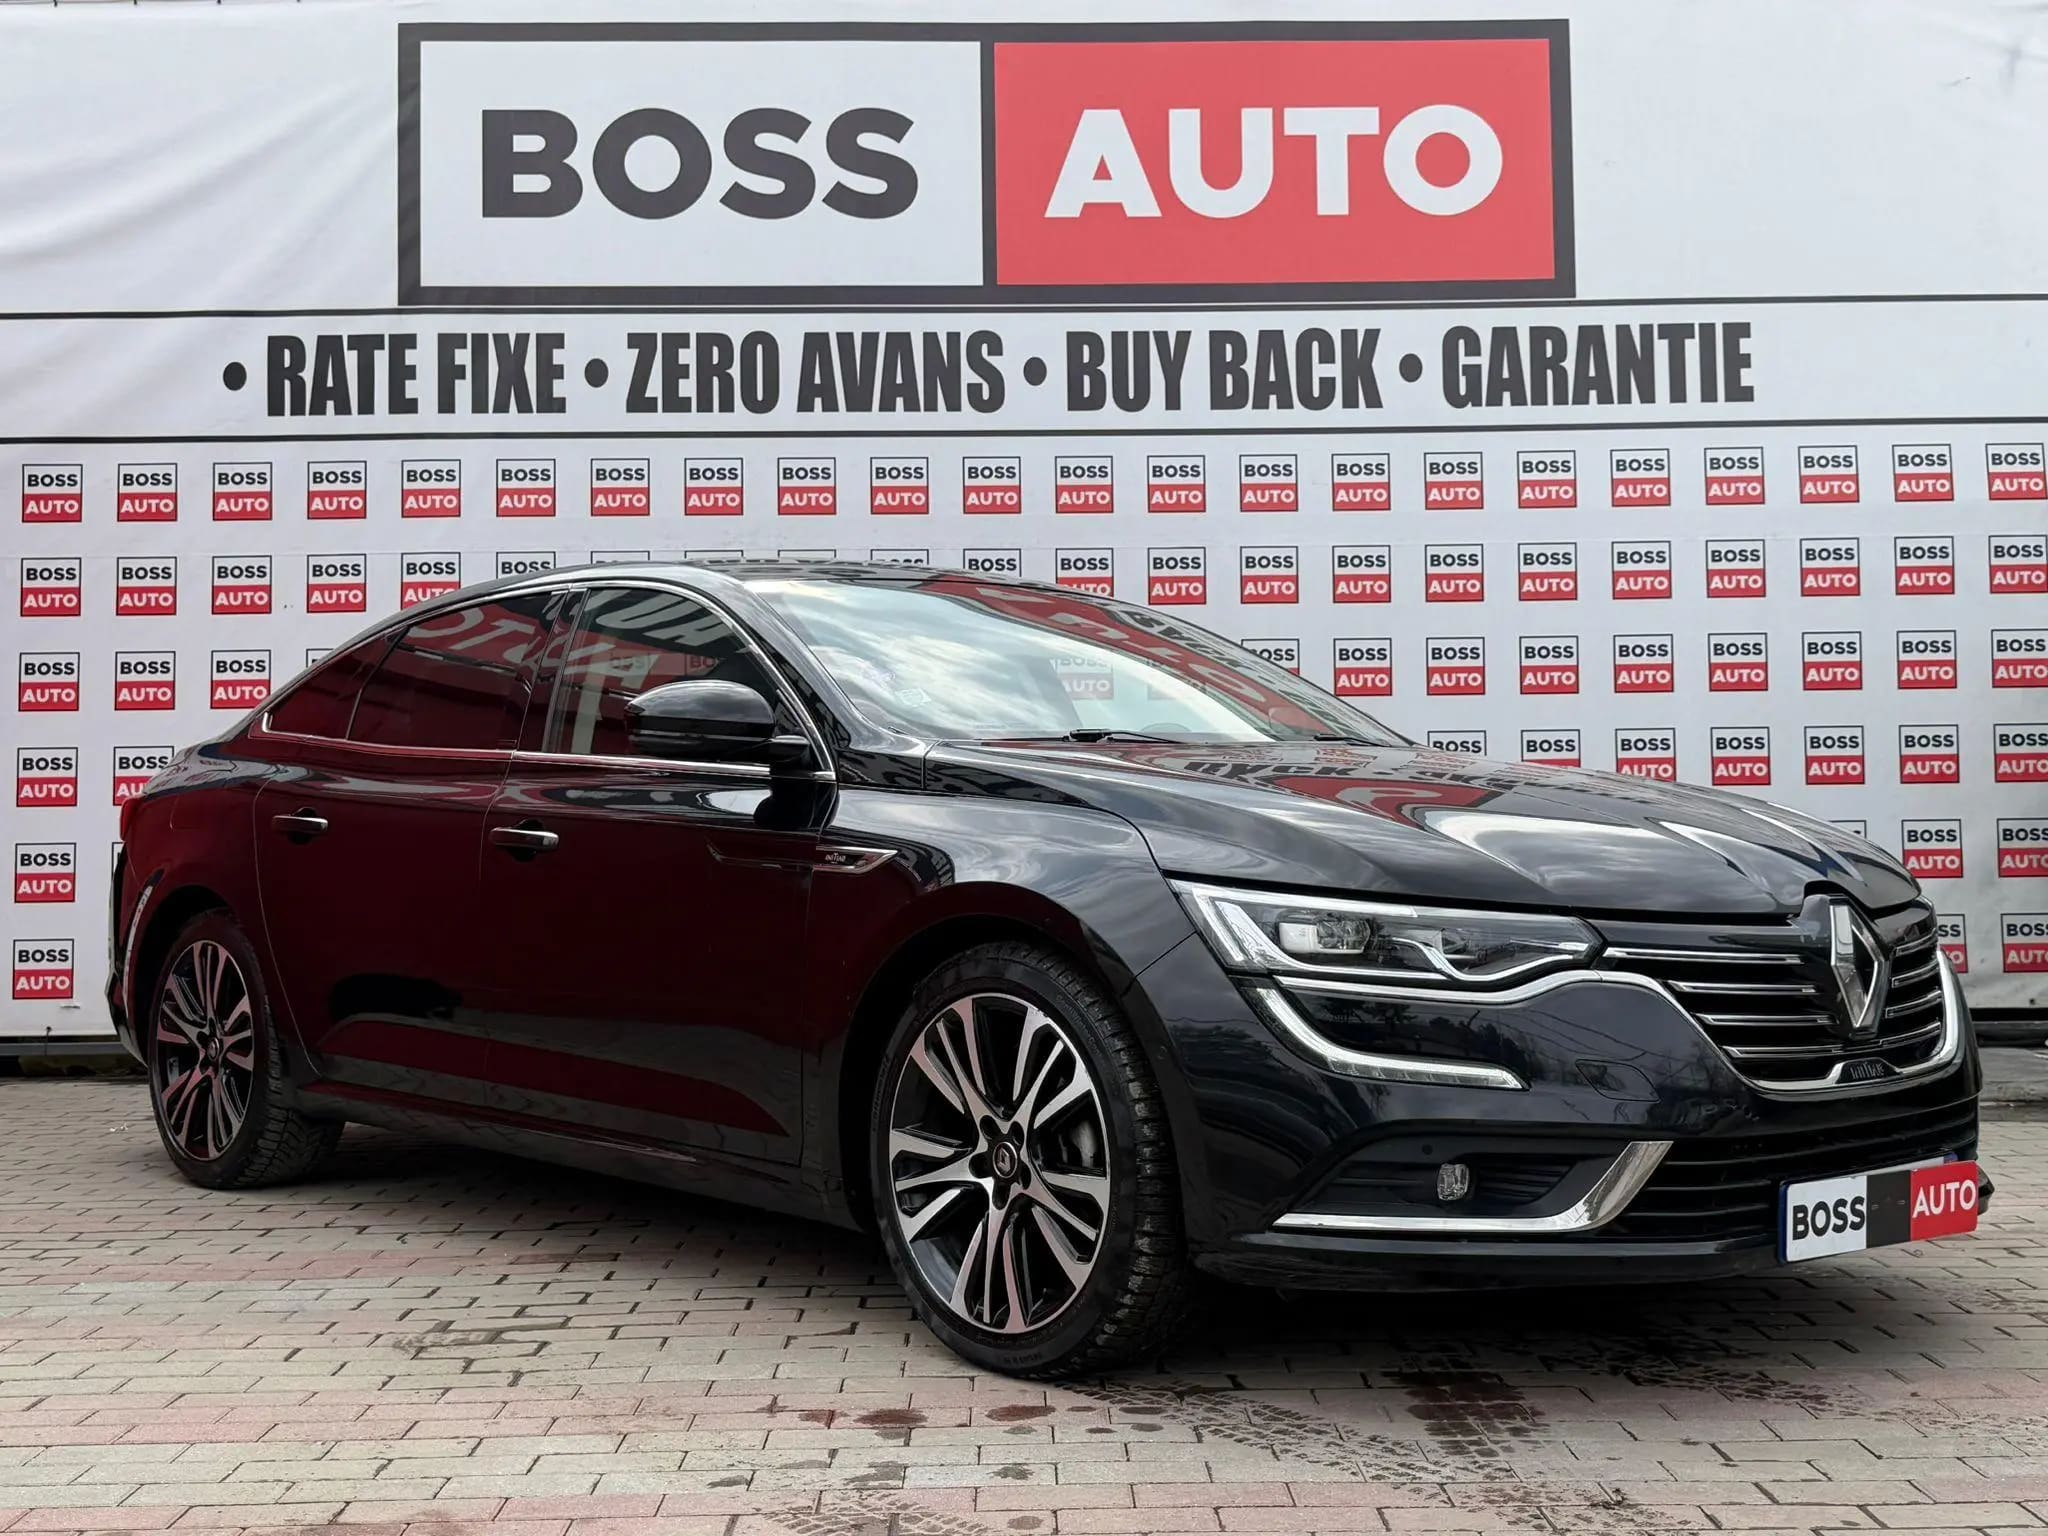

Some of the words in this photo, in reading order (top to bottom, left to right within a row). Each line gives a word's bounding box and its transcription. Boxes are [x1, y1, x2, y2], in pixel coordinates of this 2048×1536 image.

[481, 107, 918, 220] BOSS
[1044, 103, 1504, 219] AUTO
[267, 332, 419, 417] RATE
[437, 331, 567, 414] FIXE
[625, 330, 780, 415] ZERO
[796, 330, 1006, 414] AVANS
[1066, 330, 1192, 412] BUY
[1208, 327, 1384, 411] BACK
[1442, 322, 1755, 409] GARANTIE
[1522, 459, 1572, 474] BOSS
[1617, 458, 1666, 472] BOSS
[1710, 456, 1760, 471] BOSS
[1804, 454, 1854, 469] BOSS
[1898, 453, 1948, 467] BOSS
[1992, 452, 2041, 466] BOSS
[406, 468, 457, 483] BOSS
[501, 468, 552, 482] BOSS
[595, 467, 646, 482] BOSS
[689, 467, 739, 481] BOSS
[782, 466, 832, 481] BOSS
[875, 466, 924, 480] BOSS
[967, 465, 1017, 480] BOSS
[1060, 465, 1109, 479] BOSS
[1152, 464, 1201, 478] BOSS
[1244, 463, 1293, 478] BOSS
[1337, 462, 1386, 477] BOSS
[1429, 461, 1479, 476] BOSS
[27, 473, 78, 488] BOSS
[122, 472, 173, 487] BOSS
[217, 471, 268, 486] BOSS
[312, 470, 363, 485] BOSS
[1991, 477, 2044, 492] AUTO
[1521, 485, 1574, 500] AUTO
[1616, 483, 1668, 498] AUTO
[1709, 481, 1762, 497] AUTO
[1803, 480, 1857, 496] AUTO
[1897, 478, 1951, 494] AUTO
[405, 494, 458, 509] AUTO
[499, 494, 553, 508] AUTO
[594, 493, 647, 508] AUTO
[688, 493, 741, 507] AUTO
[781, 492, 833, 507] AUTO
[873, 492, 926, 506] AUTO
[966, 491, 1018, 506] AUTO
[1059, 490, 1111, 505] AUTO
[1150, 490, 1203, 505] AUTO
[1243, 489, 1296, 504] AUTO
[1336, 488, 1388, 503] AUTO
[1428, 486, 1481, 502] AUTO
[25, 500, 79, 514] AUTO
[120, 498, 175, 513] AUTO
[216, 497, 269, 512] AUTO
[310, 496, 364, 511] AUTO
[1523, 551, 1573, 566] BOSS
[1617, 550, 1667, 565] BOSS
[1711, 548, 1761, 563] BOSS
[1805, 547, 1855, 562] BOSS
[1899, 545, 1950, 560] BOSS
[1993, 544, 2044, 559] BOSS
[967, 558, 1017, 572] BOSS
[1061, 557, 1109, 571] BOSS
[1152, 556, 1202, 570] BOSS
[1245, 555, 1294, 569] BOSS
[1337, 554, 1387, 568] BOSS
[1430, 553, 1479, 567] BOSS
[26, 567, 77, 581] BOSS
[121, 566, 173, 580] BOSS
[217, 565, 267, 579] BOSS
[312, 563, 362, 578] BOSS
[406, 561, 457, 576] BOSS
[1616, 576, 1669, 591] AUTO
[1710, 574, 1763, 590] AUTO
[1804, 573, 1857, 588] AUTO
[1898, 572, 1952, 587] AUTO
[1992, 570, 2046, 585] AUTO
[1151, 582, 1204, 597] AUTO
[1244, 581, 1296, 596] AUTO
[1336, 580, 1388, 595] AUTO
[1429, 579, 1481, 594] AUTO
[1521, 578, 1575, 593] AUTO
[24, 593, 78, 608] AUTO
[119, 592, 174, 607] AUTO
[215, 591, 269, 606] AUTO
[309, 589, 363, 604] AUTO
[404, 588, 455, 603] AUT
[1524, 645, 1574, 659] BOSS
[1618, 643, 1669, 658] BOSS
[1713, 642, 1763, 657] BOSS
[1807, 641, 1858, 655] BOSS
[1902, 639, 1952, 654] BOSS
[1997, 638, 2046, 653] BOSS
[1249, 648, 1296, 662] OSS
[1338, 647, 1388, 662] BOSS
[1431, 646, 1481, 661] BOSS
[24, 661, 75, 676] BOSS
[120, 660, 171, 675] BOSS
[215, 659, 267, 674] BOSS
[1901, 666, 1954, 681] AUTO
[1995, 664, 2048, 680] AUTO
[1337, 673, 1390, 688] AUTO
[1430, 672, 1483, 687] AUTO
[1523, 671, 1576, 686] AUTO
[1617, 669, 1671, 685] AUTO
[1712, 668, 1765, 683] AUTO
[1806, 667, 1860, 682] AUTO
[22, 688, 76, 703] AUTO
[118, 687, 172, 702] AUTO
[214, 686, 267, 701] AUTO
[1525, 738, 1576, 753] BOSS
[1621, 737, 1671, 752] BOSS
[1716, 736, 1766, 750] BOSS
[1810, 735, 1860, 750] BOSS
[1904, 734, 1955, 748] BOSS
[1998, 732, 2048, 747] BOSS
[22, 756, 73, 771] BOSS
[118, 756, 169, 770] BOSS
[1715, 763, 1768, 777] AUTO
[1809, 762, 1862, 776] AUTO
[1903, 760, 1956, 775] AUTO
[1998, 758, 2048, 774] AUTO
[20, 783, 74, 798] AUTO
[116, 782, 143, 798] AU
[1908, 828, 1958, 843] BOSS
[20, 852, 71, 867] BOSS
[1907, 855, 1960, 870] AUTO
[18, 879, 72, 894] AUTO
[1937, 923, 1962, 938] SS
[18, 948, 70, 963] BOSS
[16, 976, 70, 990] AUTO
[1792, 1195, 1866, 1241] BOSS
[1911, 1179, 1977, 1219] AUTO
